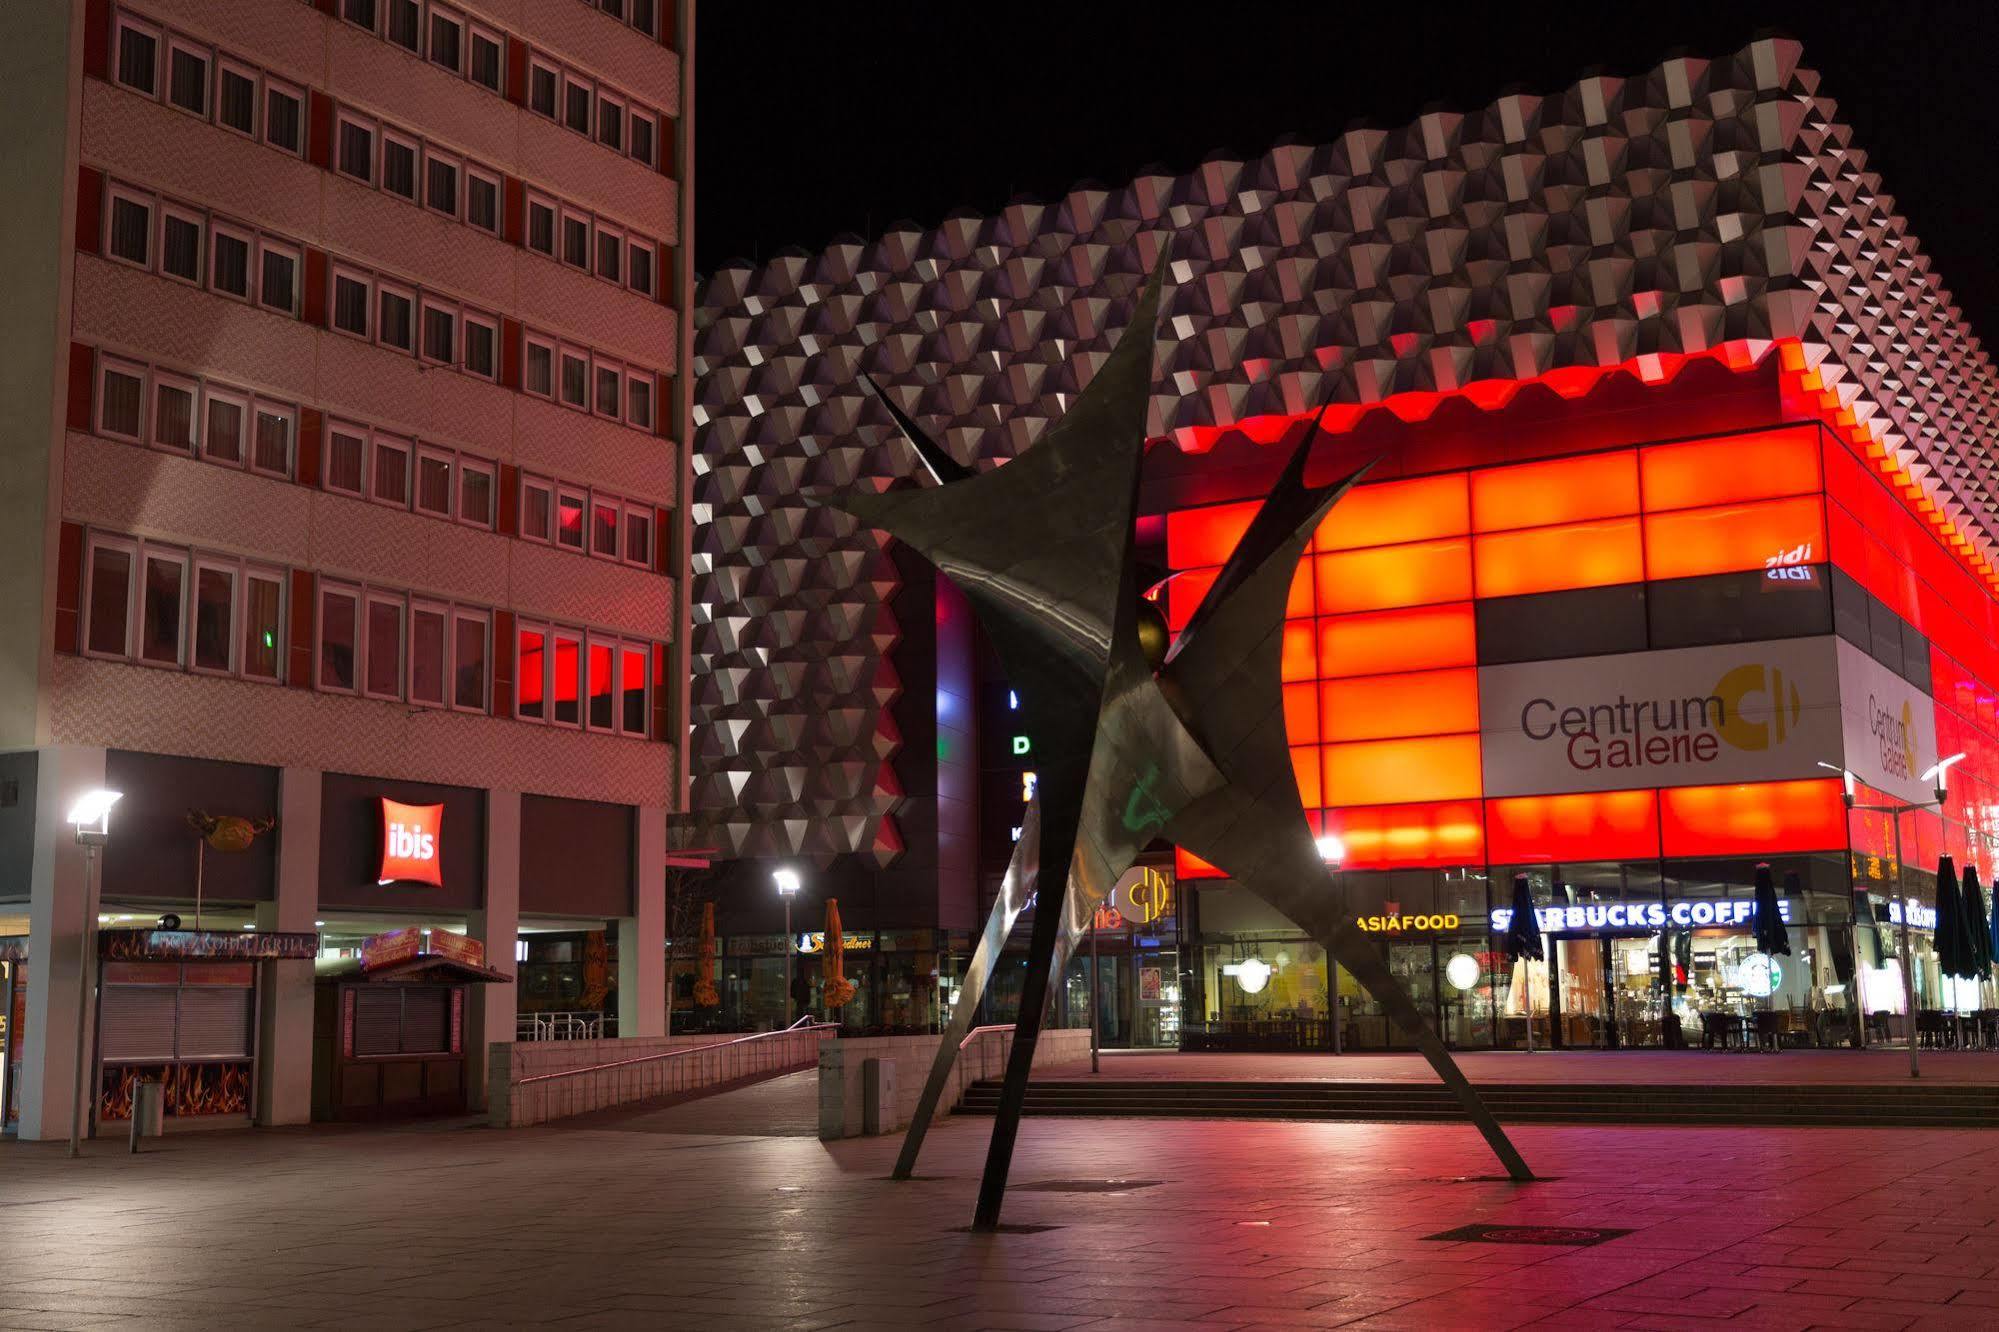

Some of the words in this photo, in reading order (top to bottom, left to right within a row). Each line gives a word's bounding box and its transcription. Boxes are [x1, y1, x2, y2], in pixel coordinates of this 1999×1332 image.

[1521, 694, 1724, 741] Centrum
[1868, 693, 1906, 748] Centrum
[1567, 731, 1719, 770] Galerie
[1879, 736, 1908, 782] Galerie
[389, 823, 433, 860] ibis
[1403, 914, 1459, 930] FOOD
